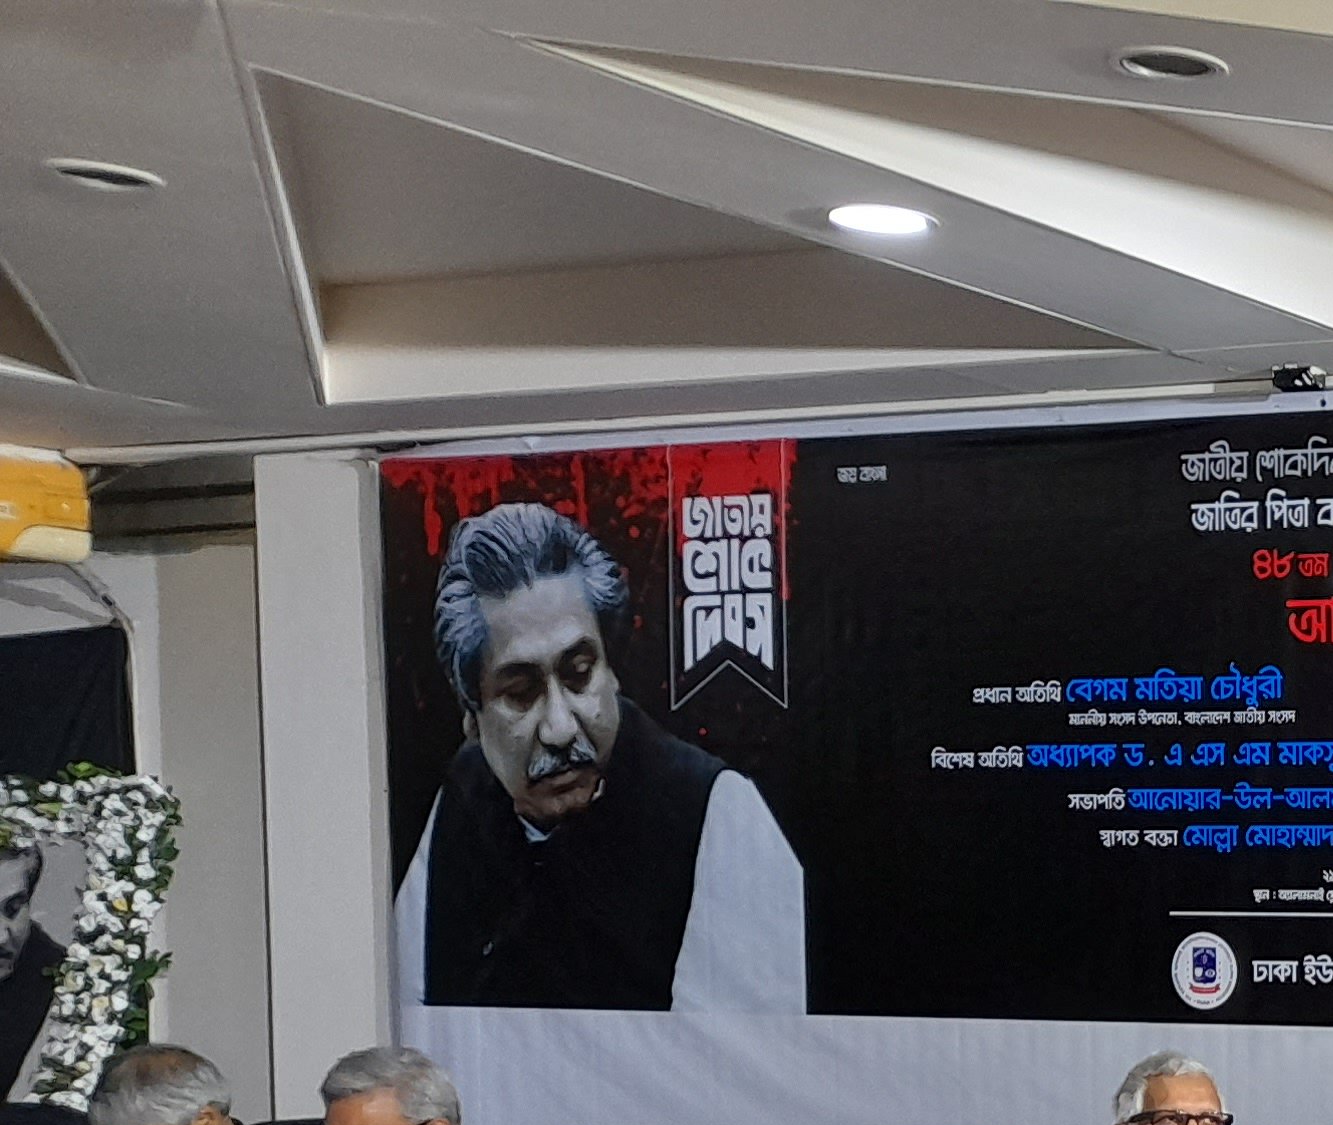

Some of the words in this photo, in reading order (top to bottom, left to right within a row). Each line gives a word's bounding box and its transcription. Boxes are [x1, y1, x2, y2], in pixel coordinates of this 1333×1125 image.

[1181, 440, 1248, 482] জাতীয়
[1191, 491, 1259, 532] জাতির
[1265, 489, 1310, 528] পিতা
[1254, 550, 1294, 579] ৪৮
[1297, 554, 1329, 576] তম
[973, 688, 1011, 703] প্রধান
[1016, 681, 1061, 702] অতিথি
[1066, 678, 1128, 702] বেগম
[1134, 668, 1203, 702] মতিয়া
[1211, 663, 1283, 707] চৌধুরী
[931, 747, 974, 769] বিশেষ
[978, 746, 1023, 767] অতিথি
[1026, 744, 1116, 767] অধ্যাপক
[1165, 744, 1182, 765] এ
[1191, 743, 1225, 766] এস
[1234, 743, 1269, 765] এম
[1068, 788, 1125, 809] সভাপতি
[1099, 830, 1139, 847] স্বাগত
[1144, 830, 1178, 846] বক্তা
[1183, 825, 1239, 852] মোল্লা
[1252, 961, 1298, 982] ঢাকা
